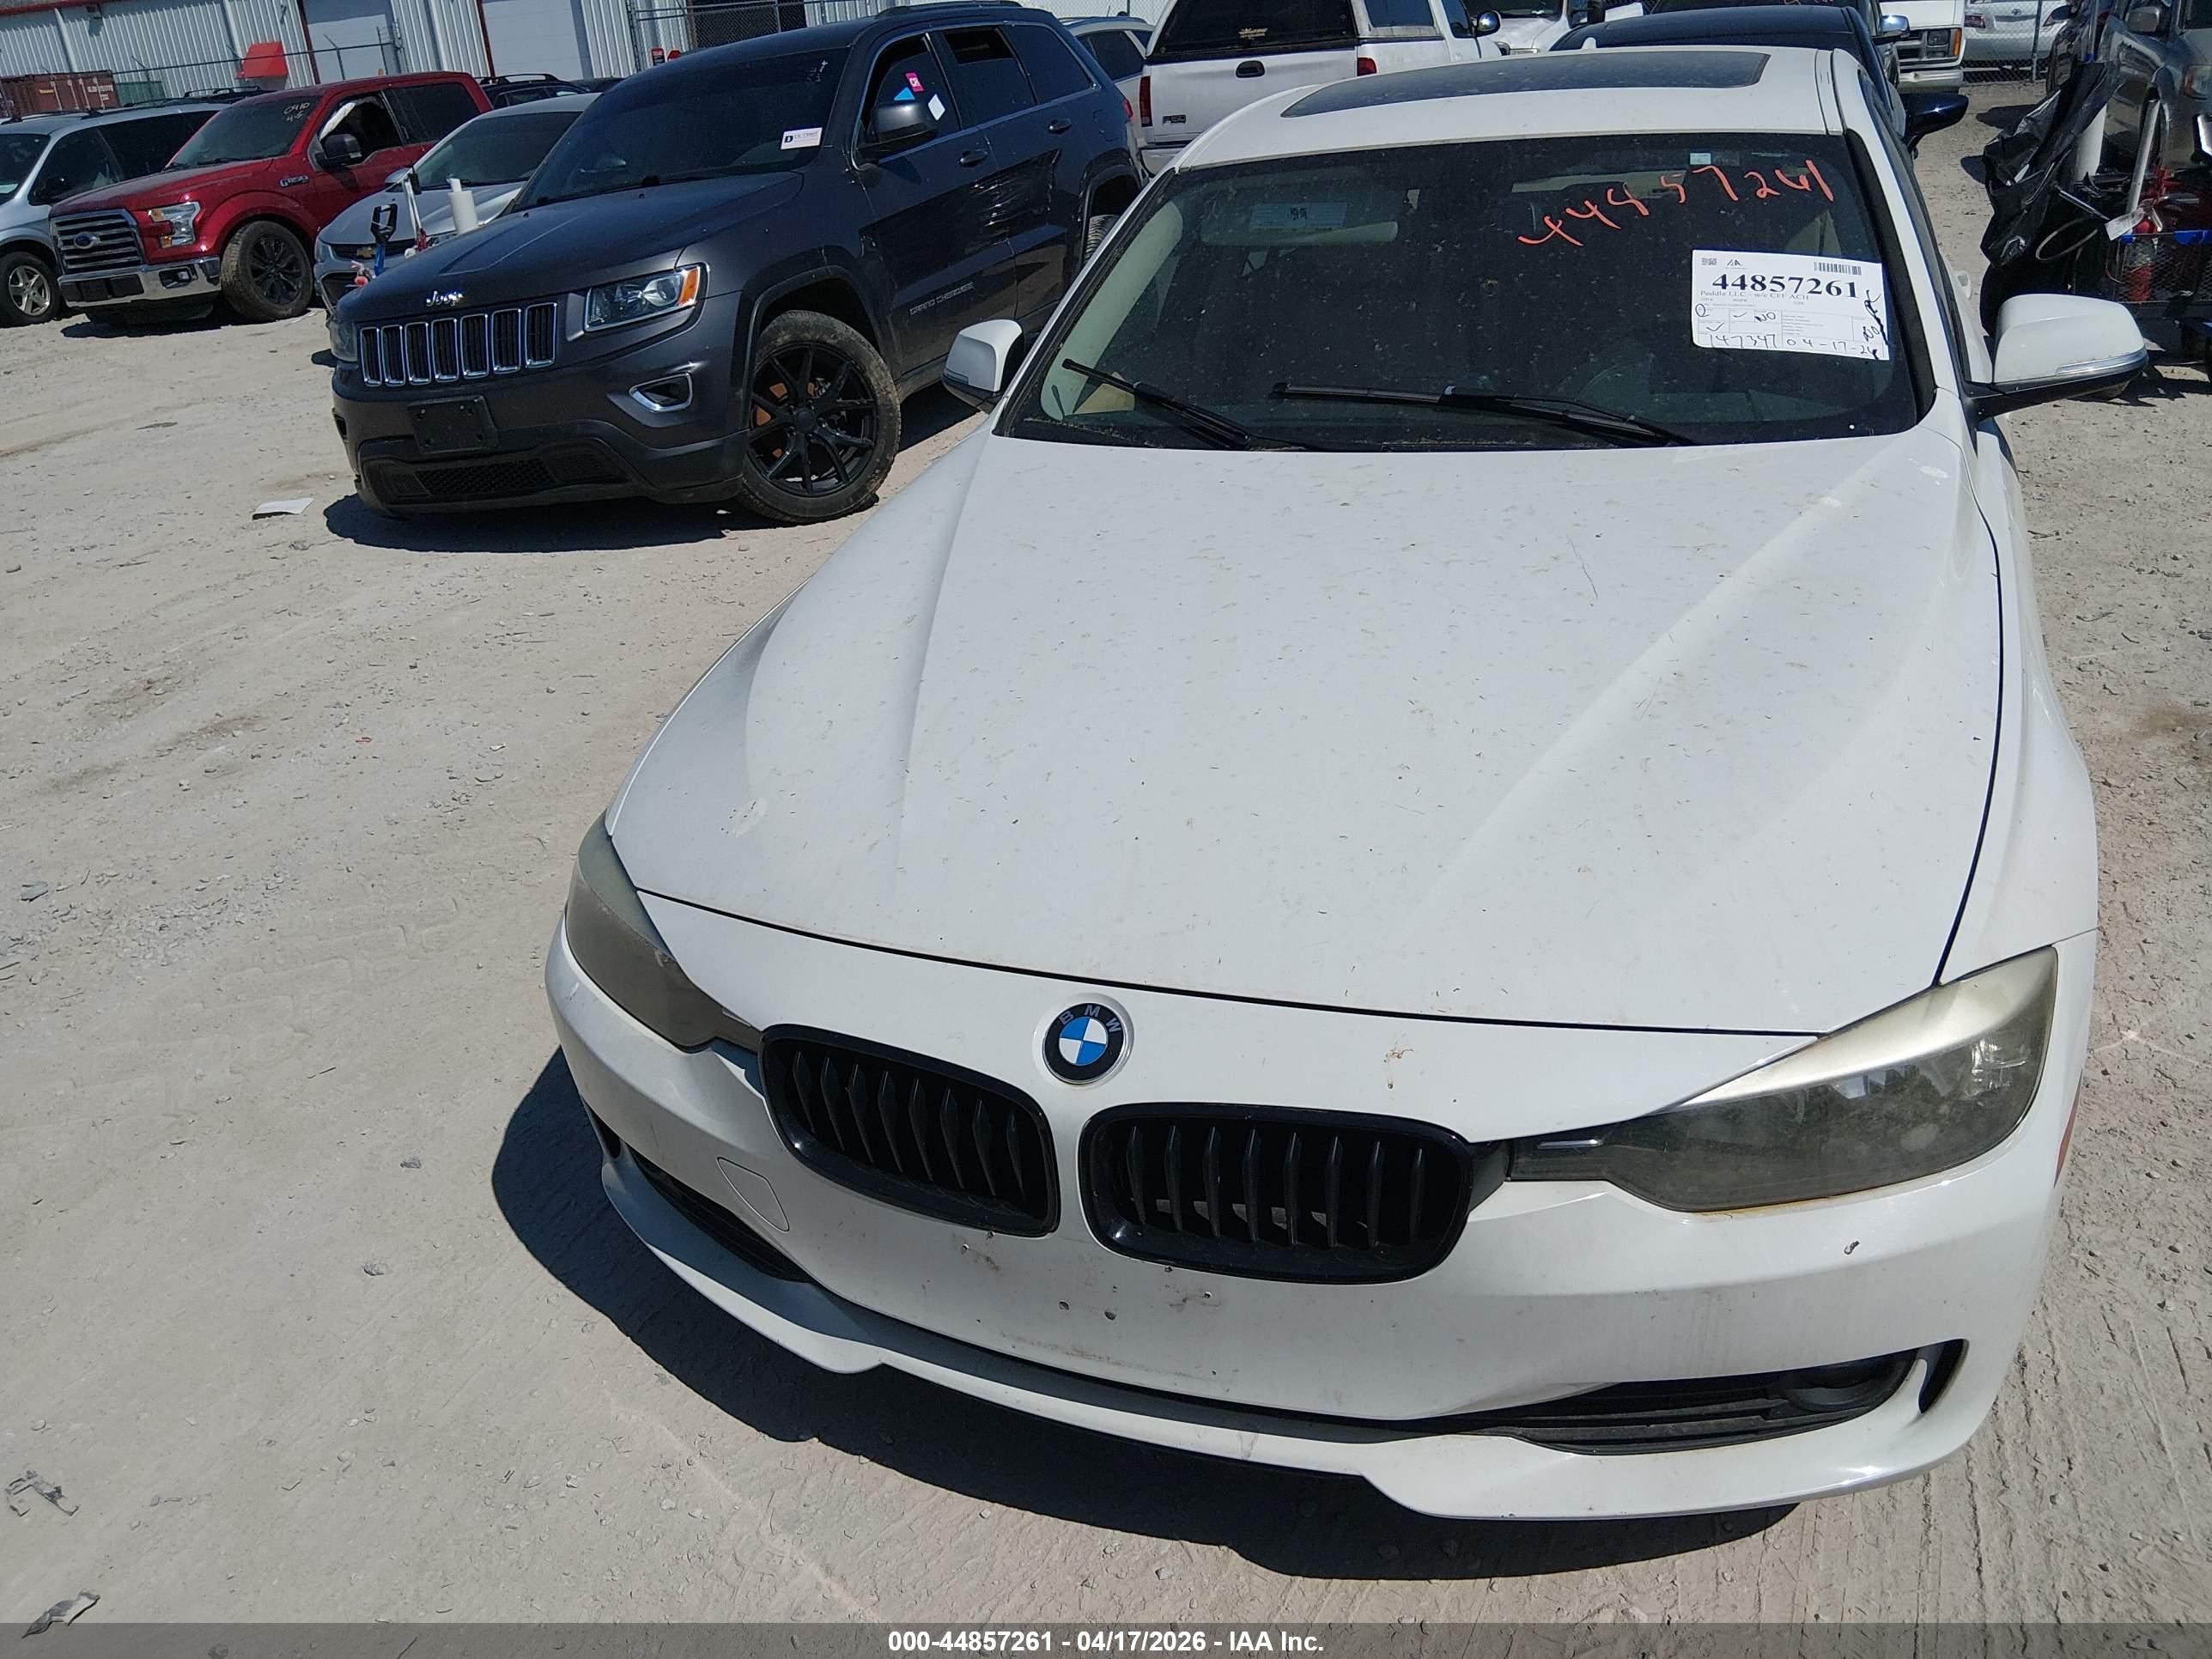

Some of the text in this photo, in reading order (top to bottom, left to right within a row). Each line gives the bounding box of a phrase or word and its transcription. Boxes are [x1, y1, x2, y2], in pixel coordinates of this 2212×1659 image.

[1712, 274, 1859, 298] 44857261
[426, 291, 463, 307] Jeep
[1059, 1005, 1121, 1033] BMW
